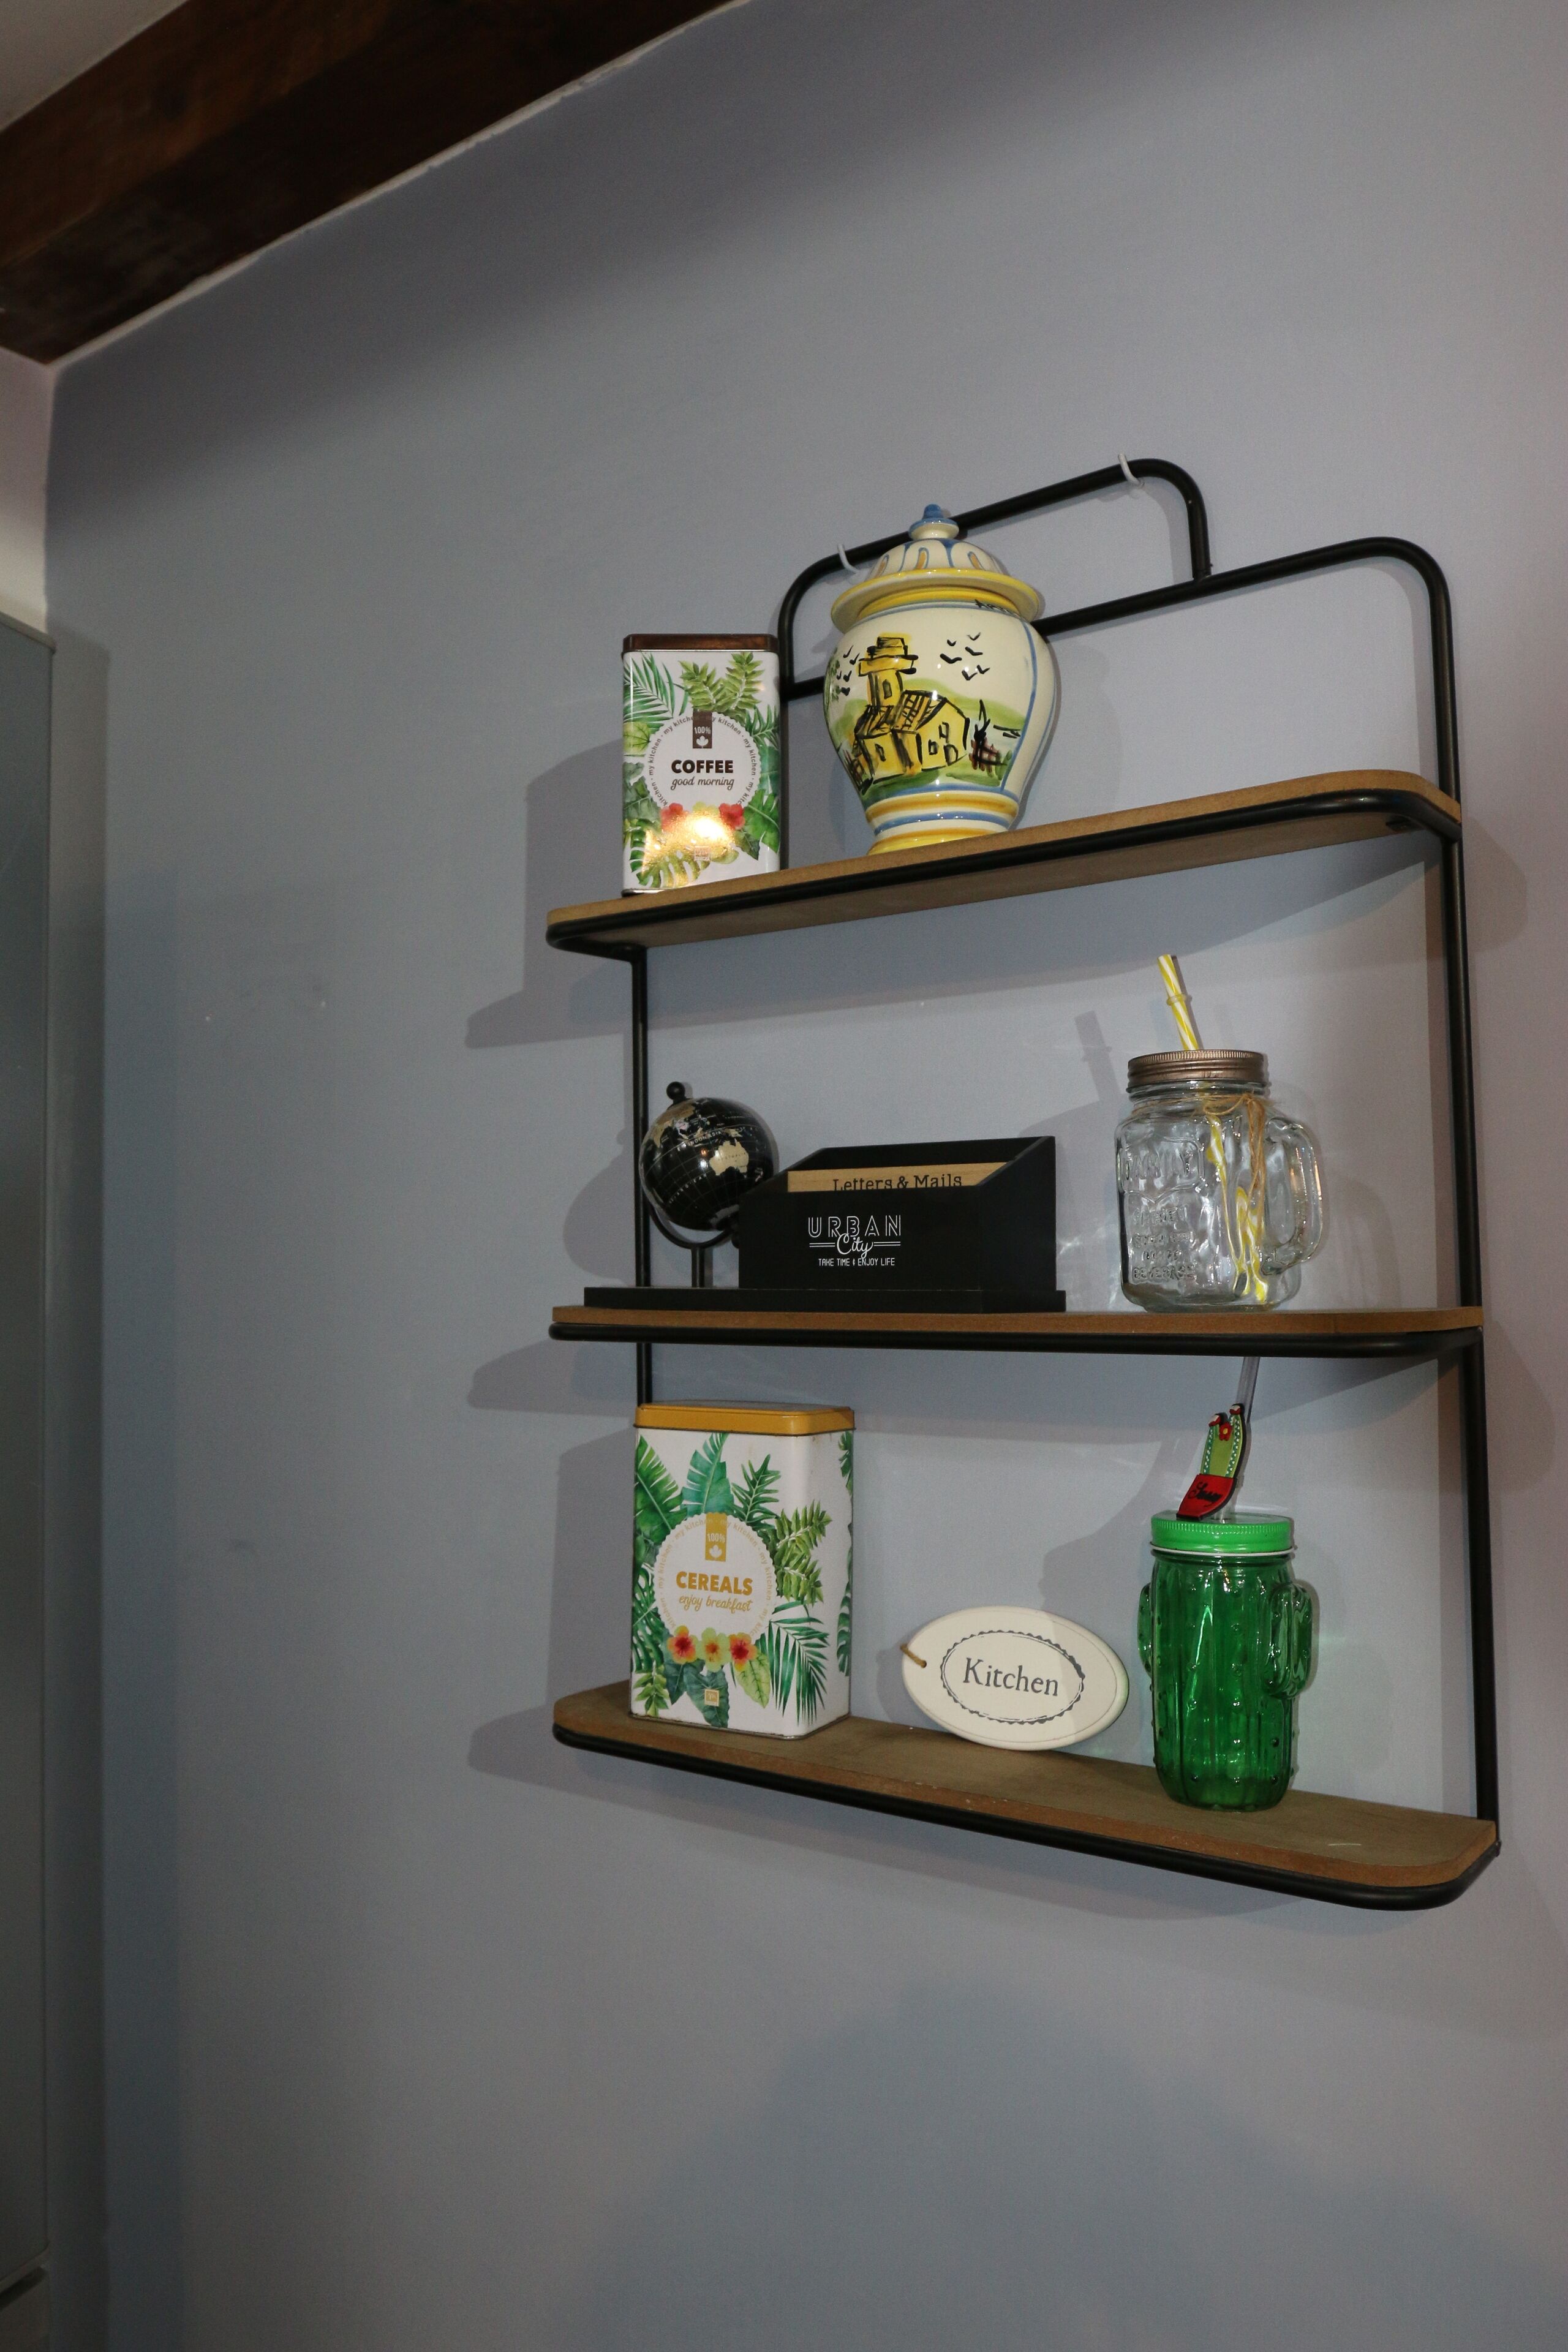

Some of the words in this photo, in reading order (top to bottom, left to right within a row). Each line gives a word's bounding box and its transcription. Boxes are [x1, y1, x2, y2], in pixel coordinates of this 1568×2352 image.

[663, 725, 673, 734] my
[718, 717, 741, 734] kitchen
[648, 738, 662, 763] kitchen
[743, 737, 752, 748] my
[649, 766, 655, 775] my
[671, 760, 734, 774] COFFEE
[670, 776, 695, 791] good
[698, 777, 734, 791] morning
[745, 782, 753, 793] my
[651, 782, 668, 806] kitchen
[833, 1177, 892, 1191] Letters
[897, 1175, 909, 1189] &
[914, 1174, 962, 1188] Mails
[808, 1215, 901, 1238] URBAN
[837, 1233, 873, 1259] City
[818, 1258, 834, 1267] TAKE
[858, 1257, 878, 1266] ENJOY
[881, 1257, 895, 1266] LIFE
[675, 1530, 685, 1540] my
[707, 1533, 726, 1544] 100%
[733, 1524, 760, 1548] kitchen
[657, 1544, 673, 1574] kitchen
[759, 1551, 767, 1565] my
[658, 1577, 665, 1588] my
[676, 1571, 753, 1596] CEREALS
[764, 1567, 773, 1600] kitchen
[679, 1594, 703, 1611] enjoy
[706, 1596, 753, 1613] breakfast
[963, 1657, 1059, 1697] Kitchen
